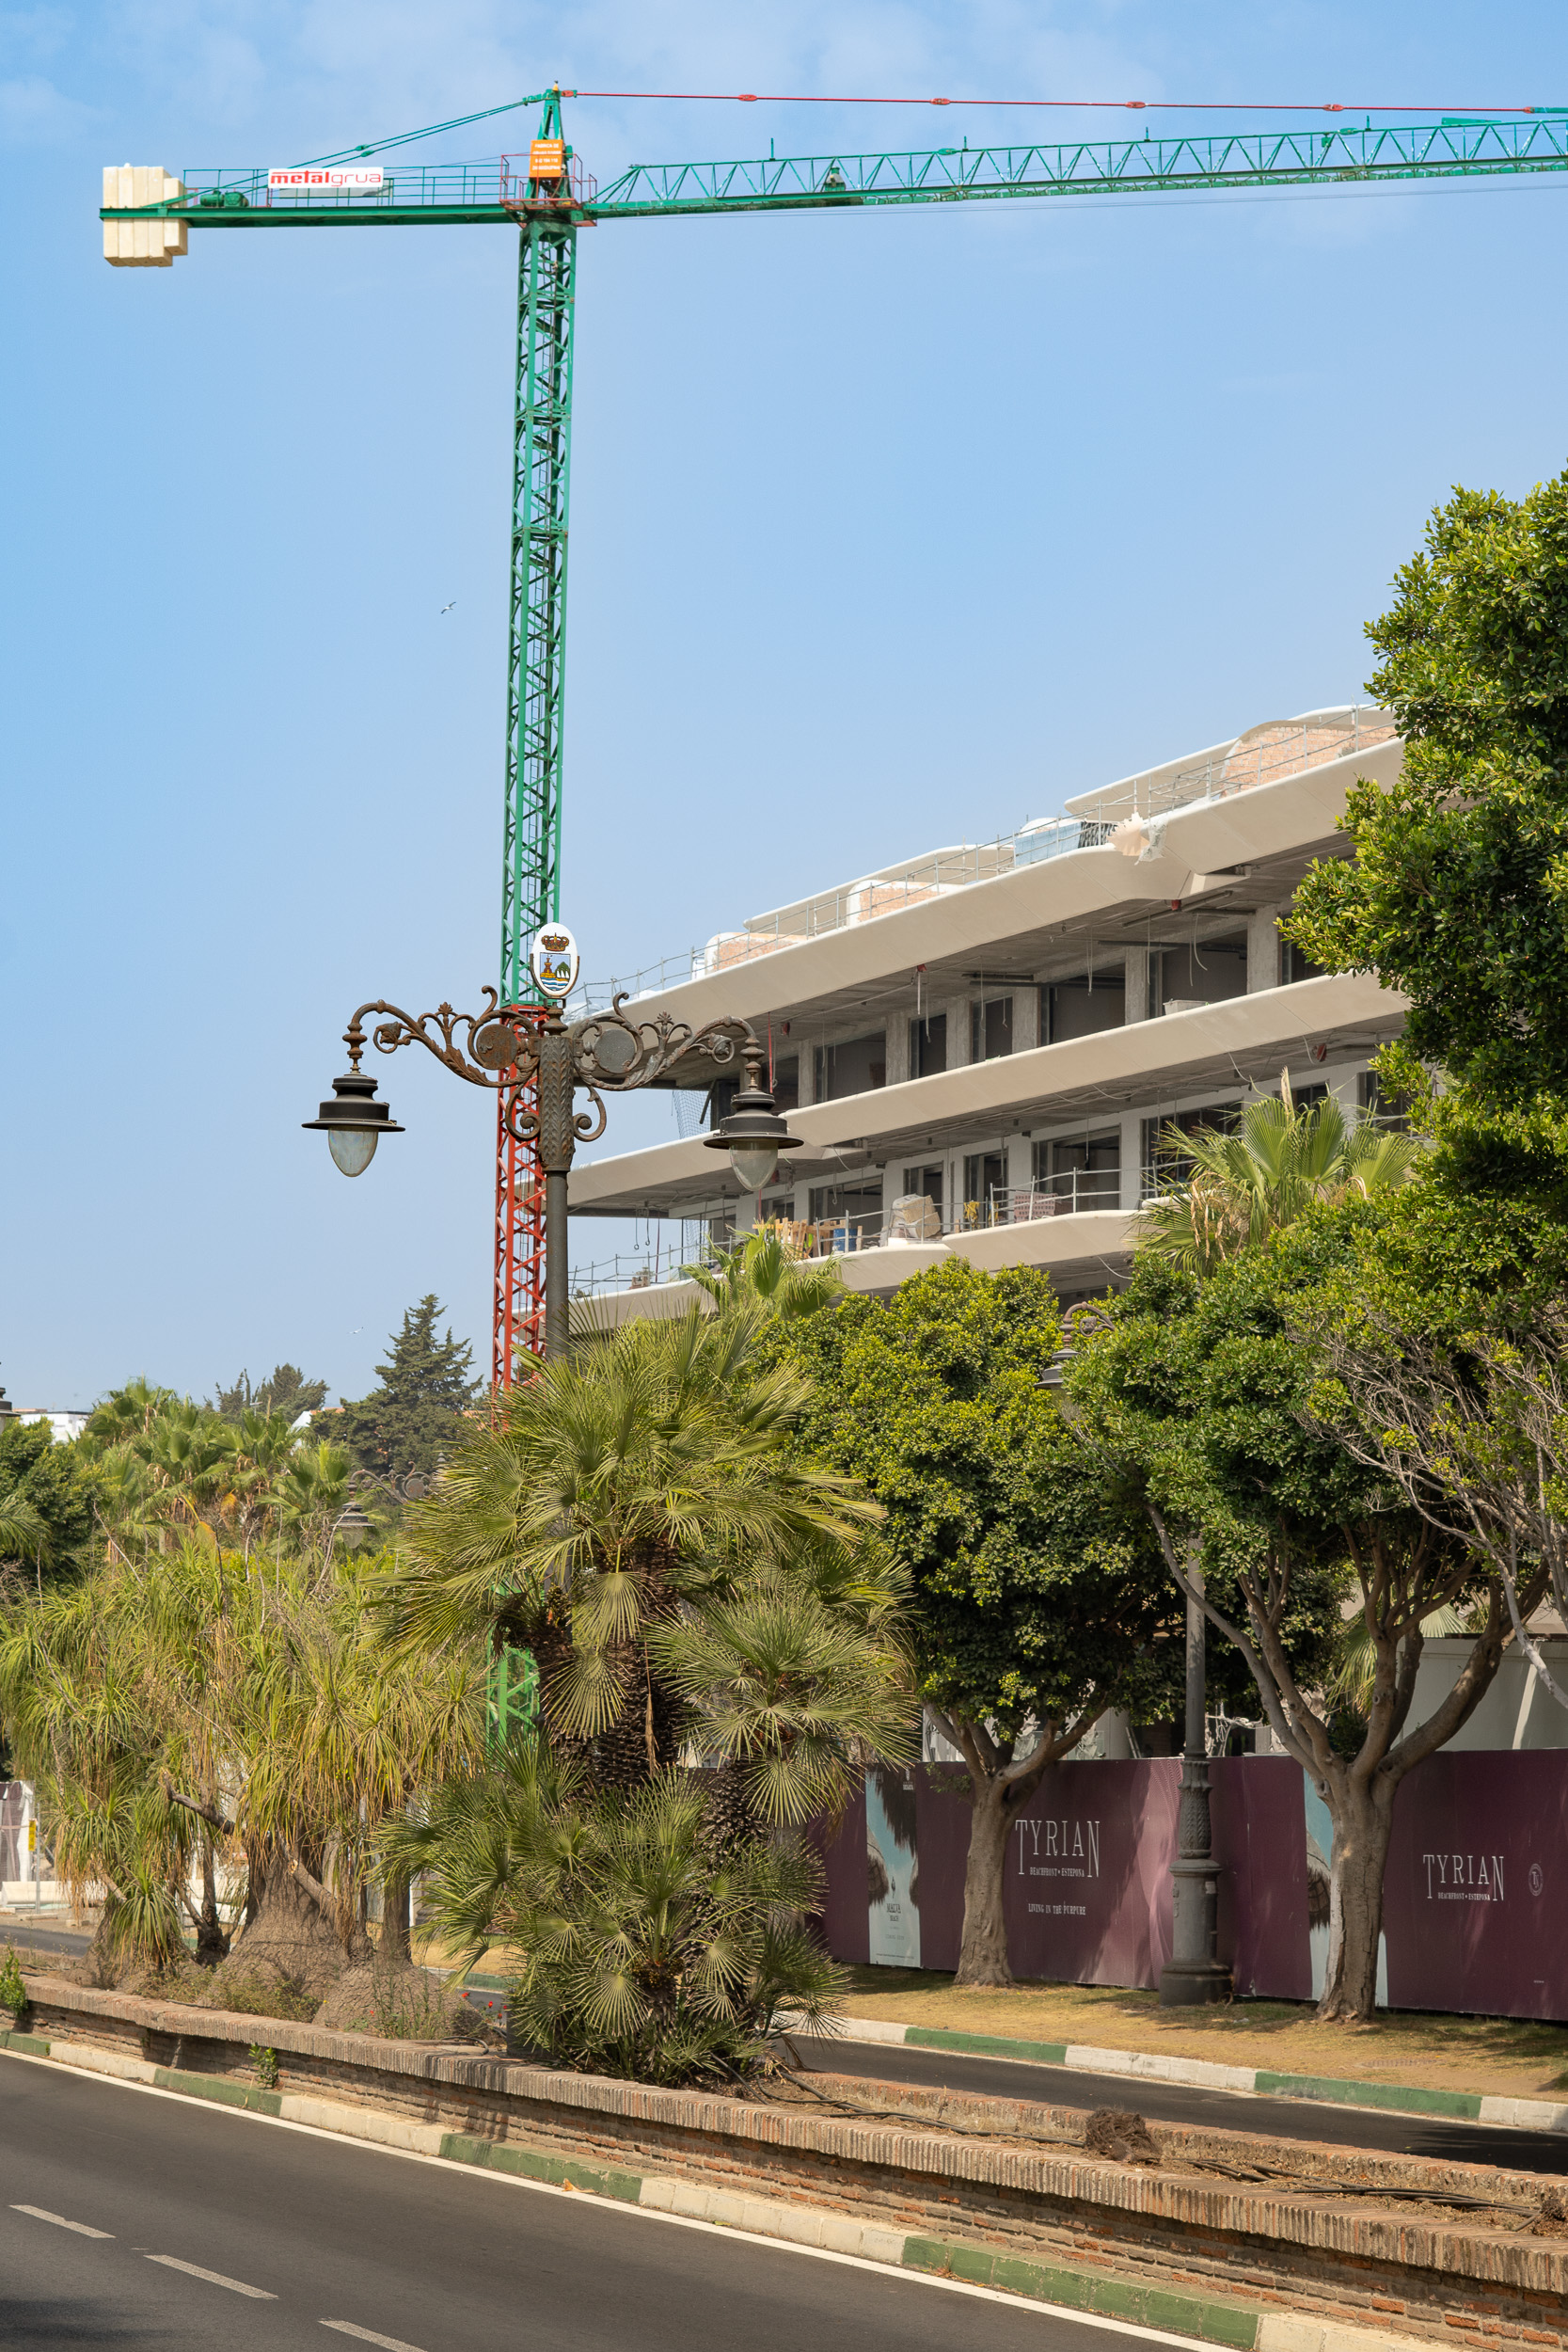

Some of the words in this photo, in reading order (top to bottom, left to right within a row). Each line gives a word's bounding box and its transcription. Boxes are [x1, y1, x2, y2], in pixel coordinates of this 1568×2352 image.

[270, 170, 381, 187] metalgrua
[1015, 1820, 1100, 1877] TYRIAN
[1029, 1867, 1057, 1877] BEACHFRONT
[1061, 1867, 1085, 1878] ESTEPONA
[1422, 1854, 1504, 1901] TYRIAN
[1437, 1892, 1465, 1900] BEACHFRONT
[1467, 1893, 1491, 1901] ESTEPONA
[1028, 1903, 1044, 1913] LIVING
[1045, 1904, 1052, 1914] IN
[1053, 1905, 1062, 1915] THE
